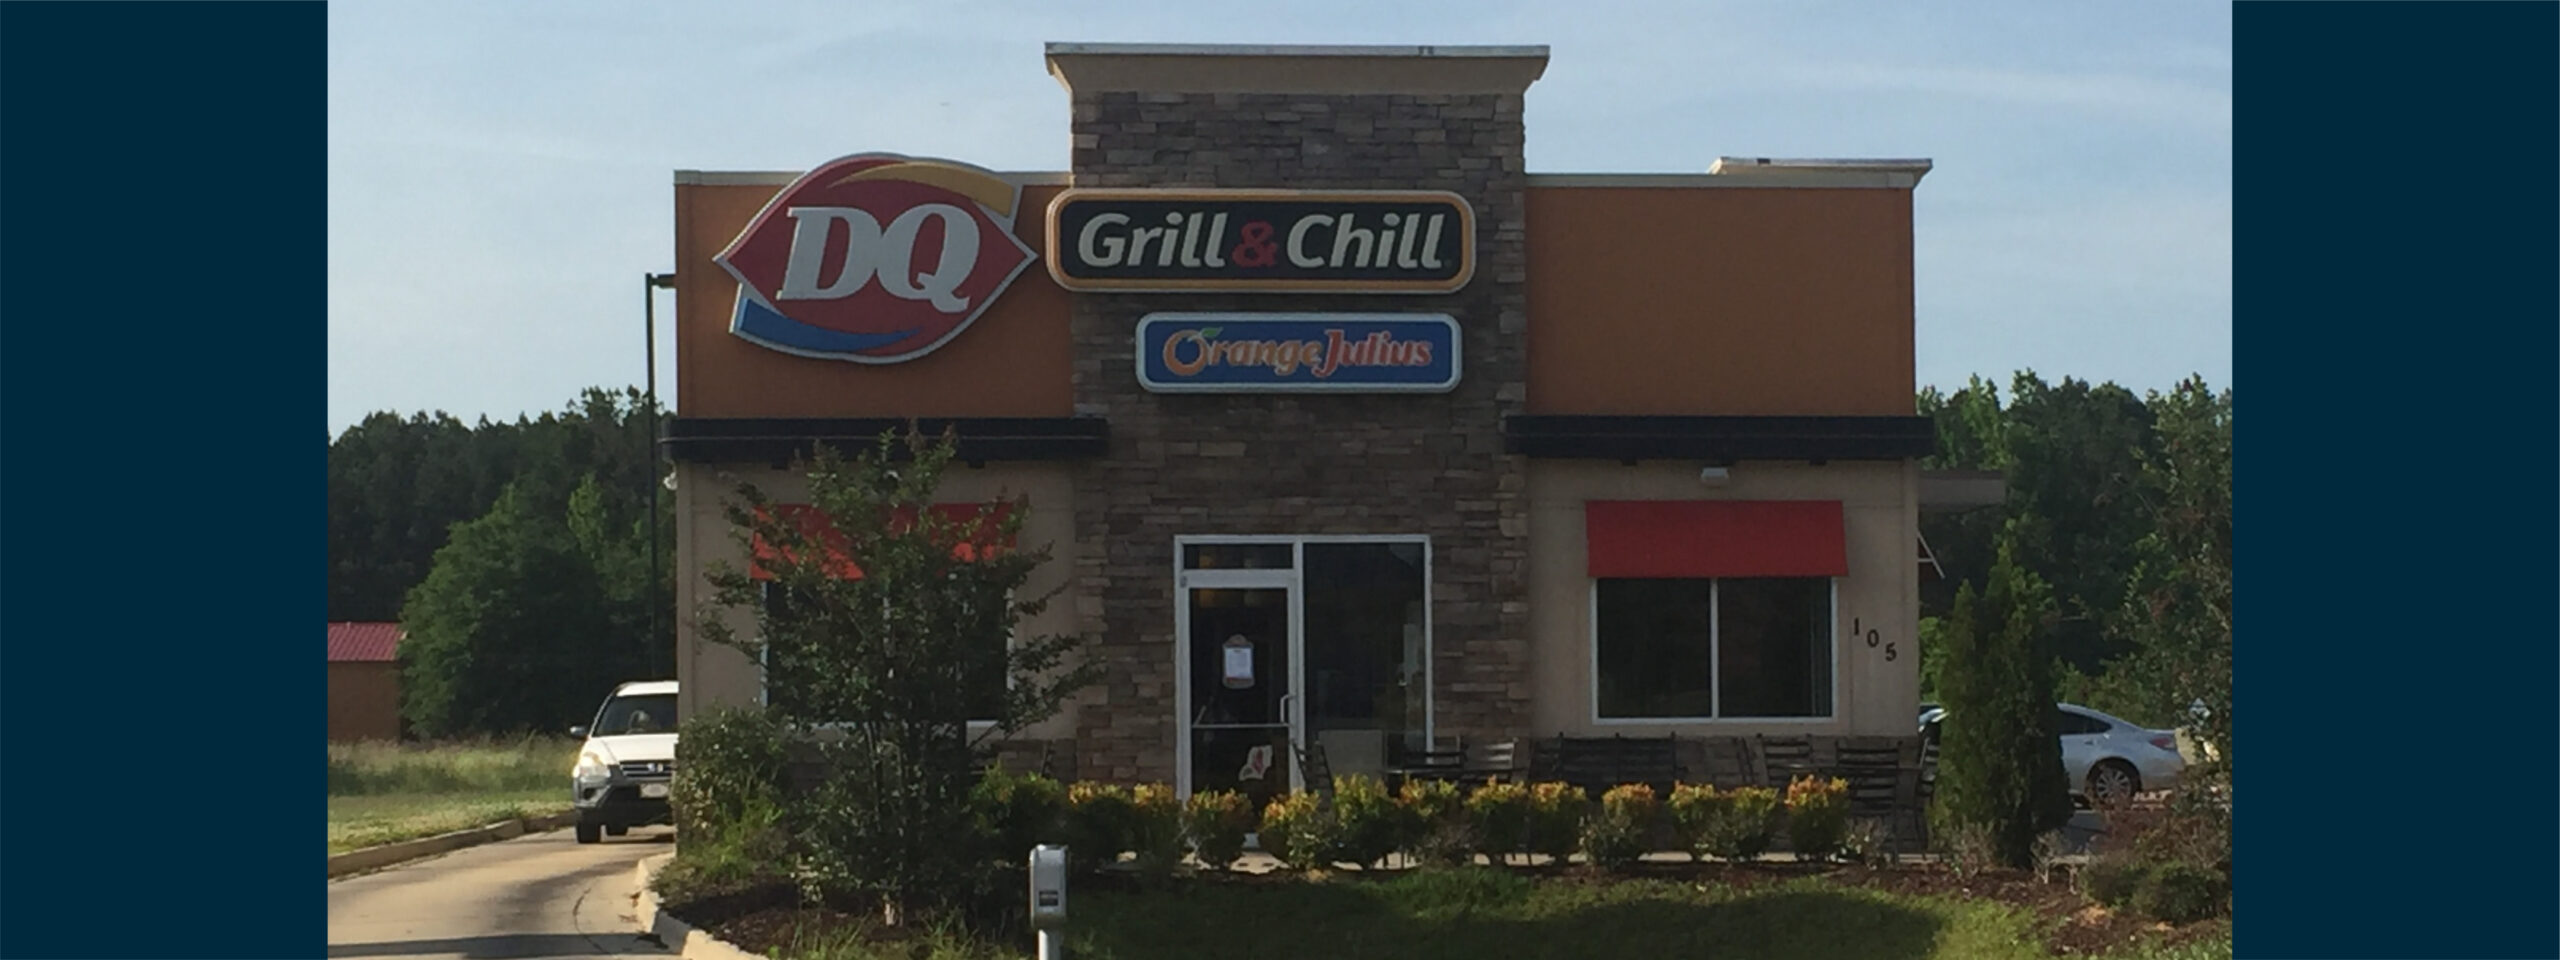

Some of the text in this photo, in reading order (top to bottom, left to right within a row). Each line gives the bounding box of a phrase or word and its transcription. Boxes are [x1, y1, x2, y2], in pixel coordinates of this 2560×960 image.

[776, 203, 981, 313] DQ
[1077, 211, 1229, 268] Grill
[1286, 212, 1445, 268] Chill
[1162, 327, 1433, 378] Orange Julius
